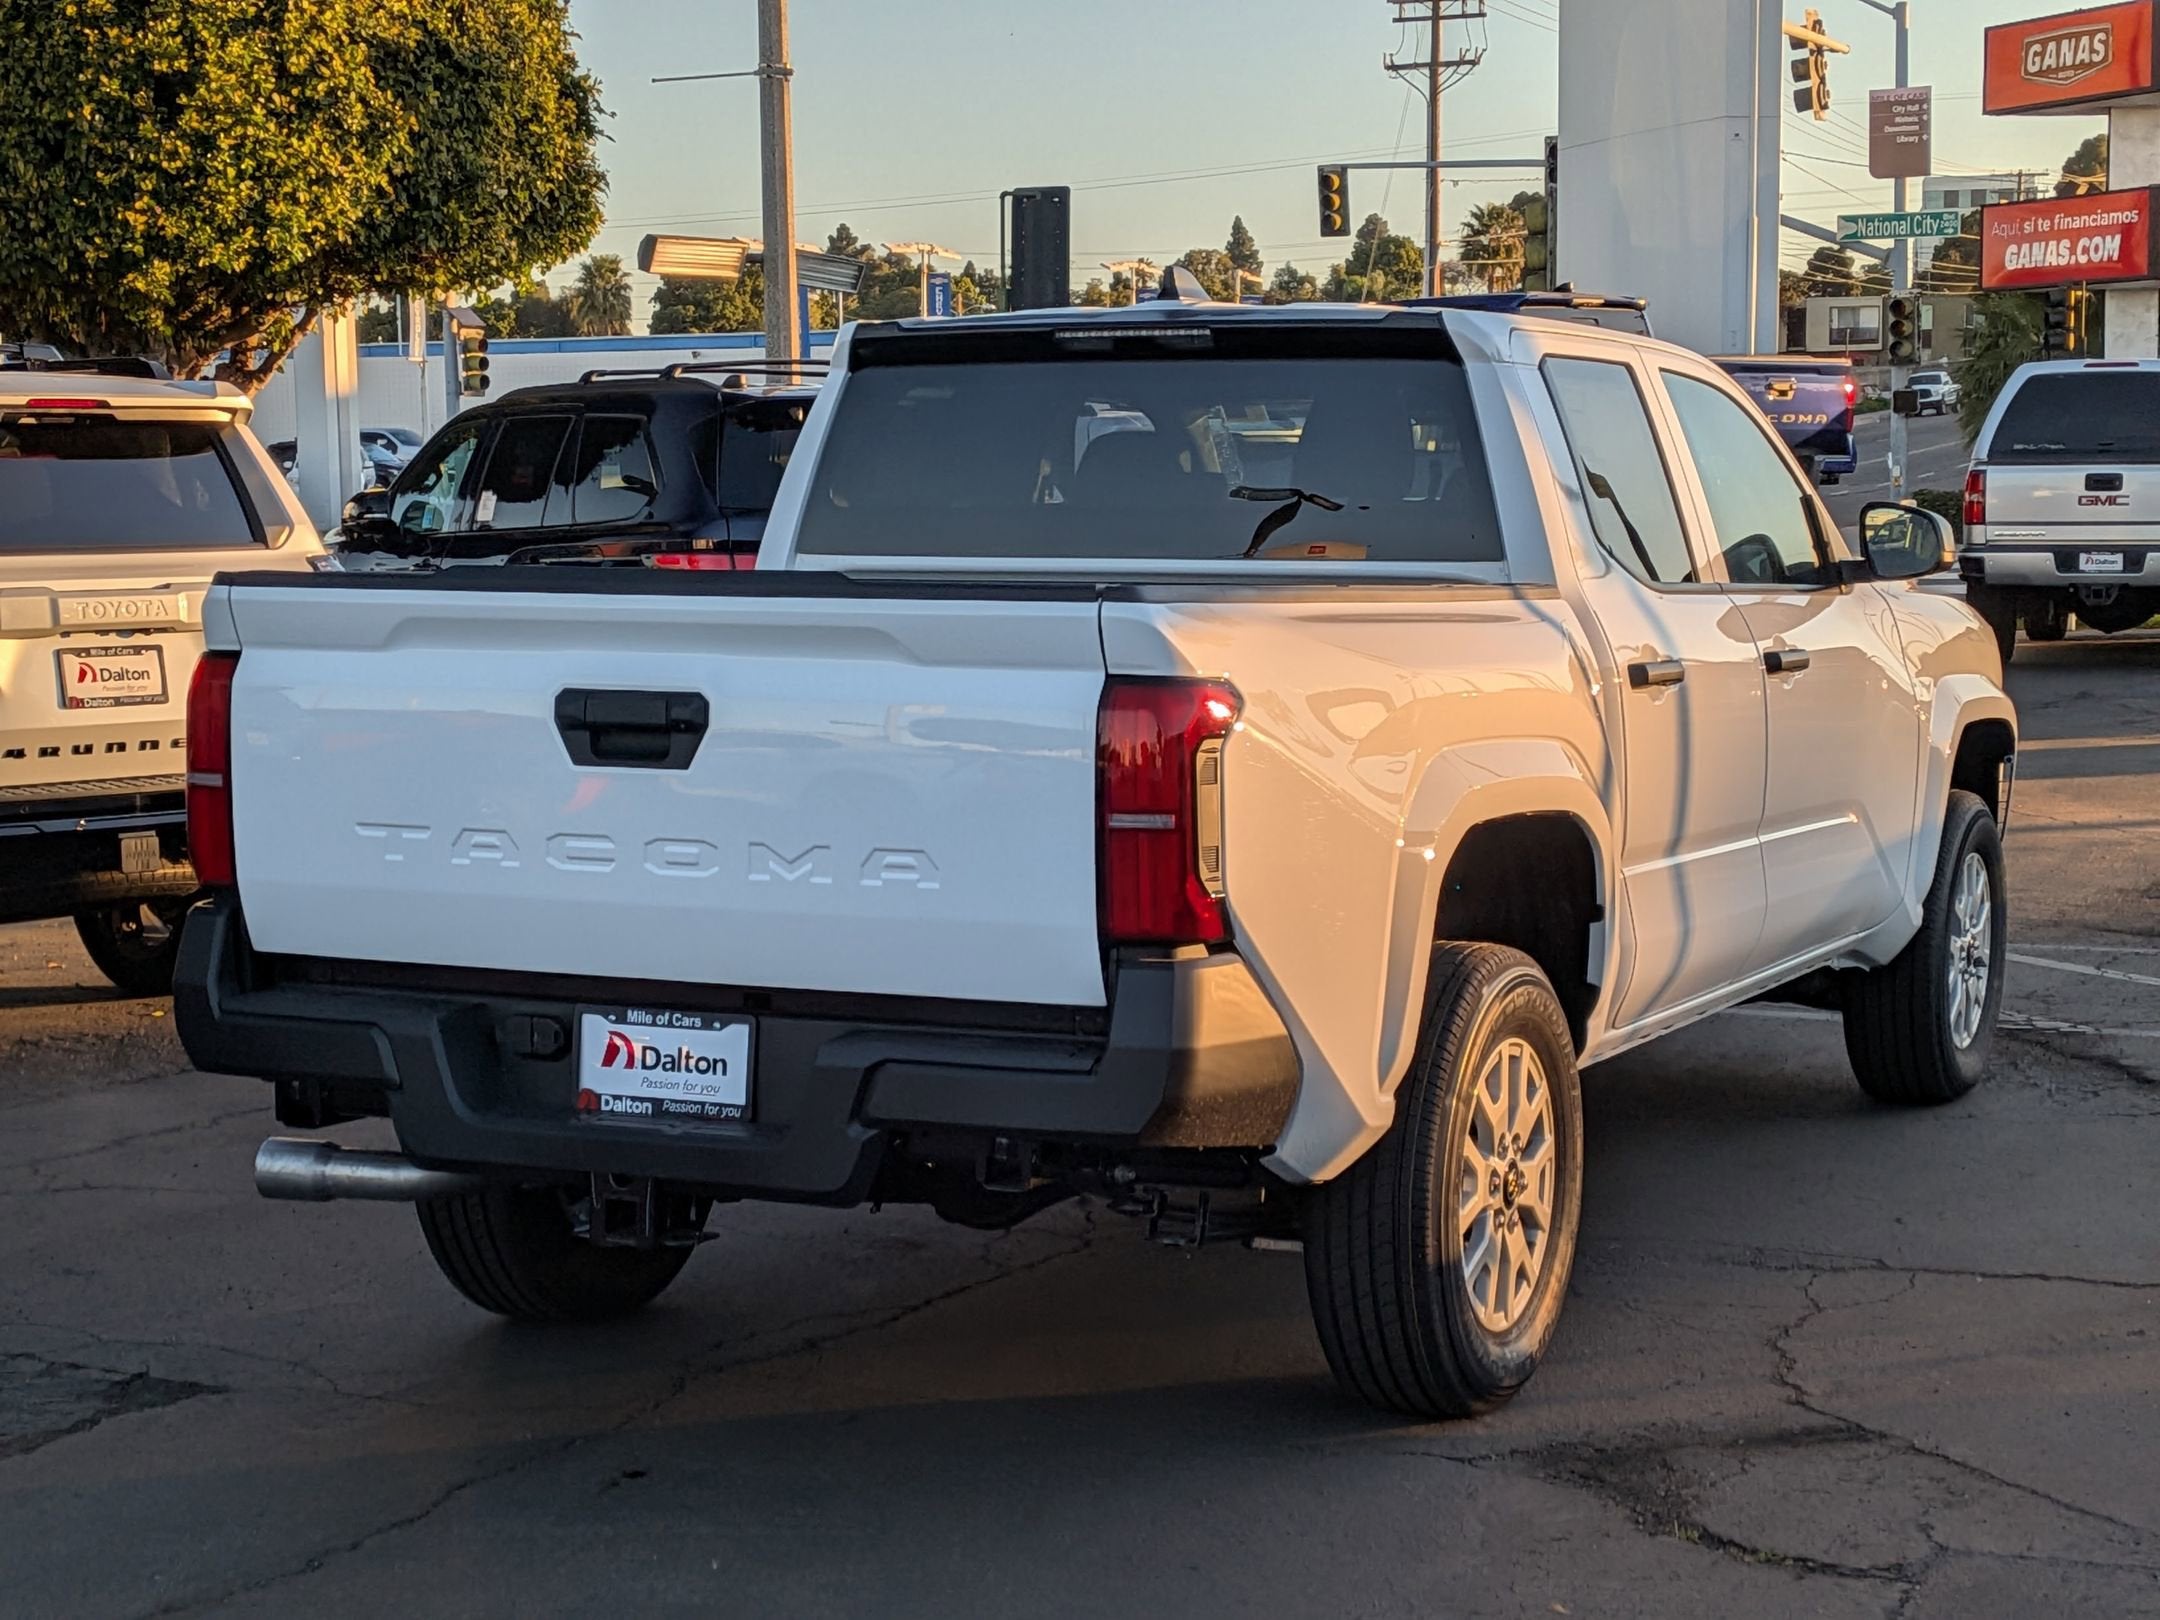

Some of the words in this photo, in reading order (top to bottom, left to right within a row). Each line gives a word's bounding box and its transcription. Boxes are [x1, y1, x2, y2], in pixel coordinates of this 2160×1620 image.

[2027, 32, 2107, 73] GANAS
[1857, 216, 1910, 237] National
[1913, 215, 1940, 235] City
[2038, 218, 2050, 232] te
[2054, 209, 2139, 230] financiamos
[2004, 234, 2121, 270] GANAS.COM
[1767, 414, 1828, 424] COMA
[2078, 495, 2130, 506] GMC
[76, 599, 169, 619] TOYOTA
[99, 667, 150, 682] Dalton
[84, 698, 115, 707] Dalton
[355, 822, 940, 889] TACOMA
[626, 1009, 651, 1024] Mile
[656, 1011, 669, 1025] of
[670, 1012, 702, 1028] Cars
[641, 1045, 728, 1076] Dalton
[640, 1076, 679, 1091] Passion
[682, 1079, 698, 1092] for
[700, 1083, 721, 1095] you
[600, 1095, 652, 1115] Dalton
[662, 1100, 702, 1114] Passion
[703, 1103, 719, 1115] for
[720, 1105, 742, 1118] you
